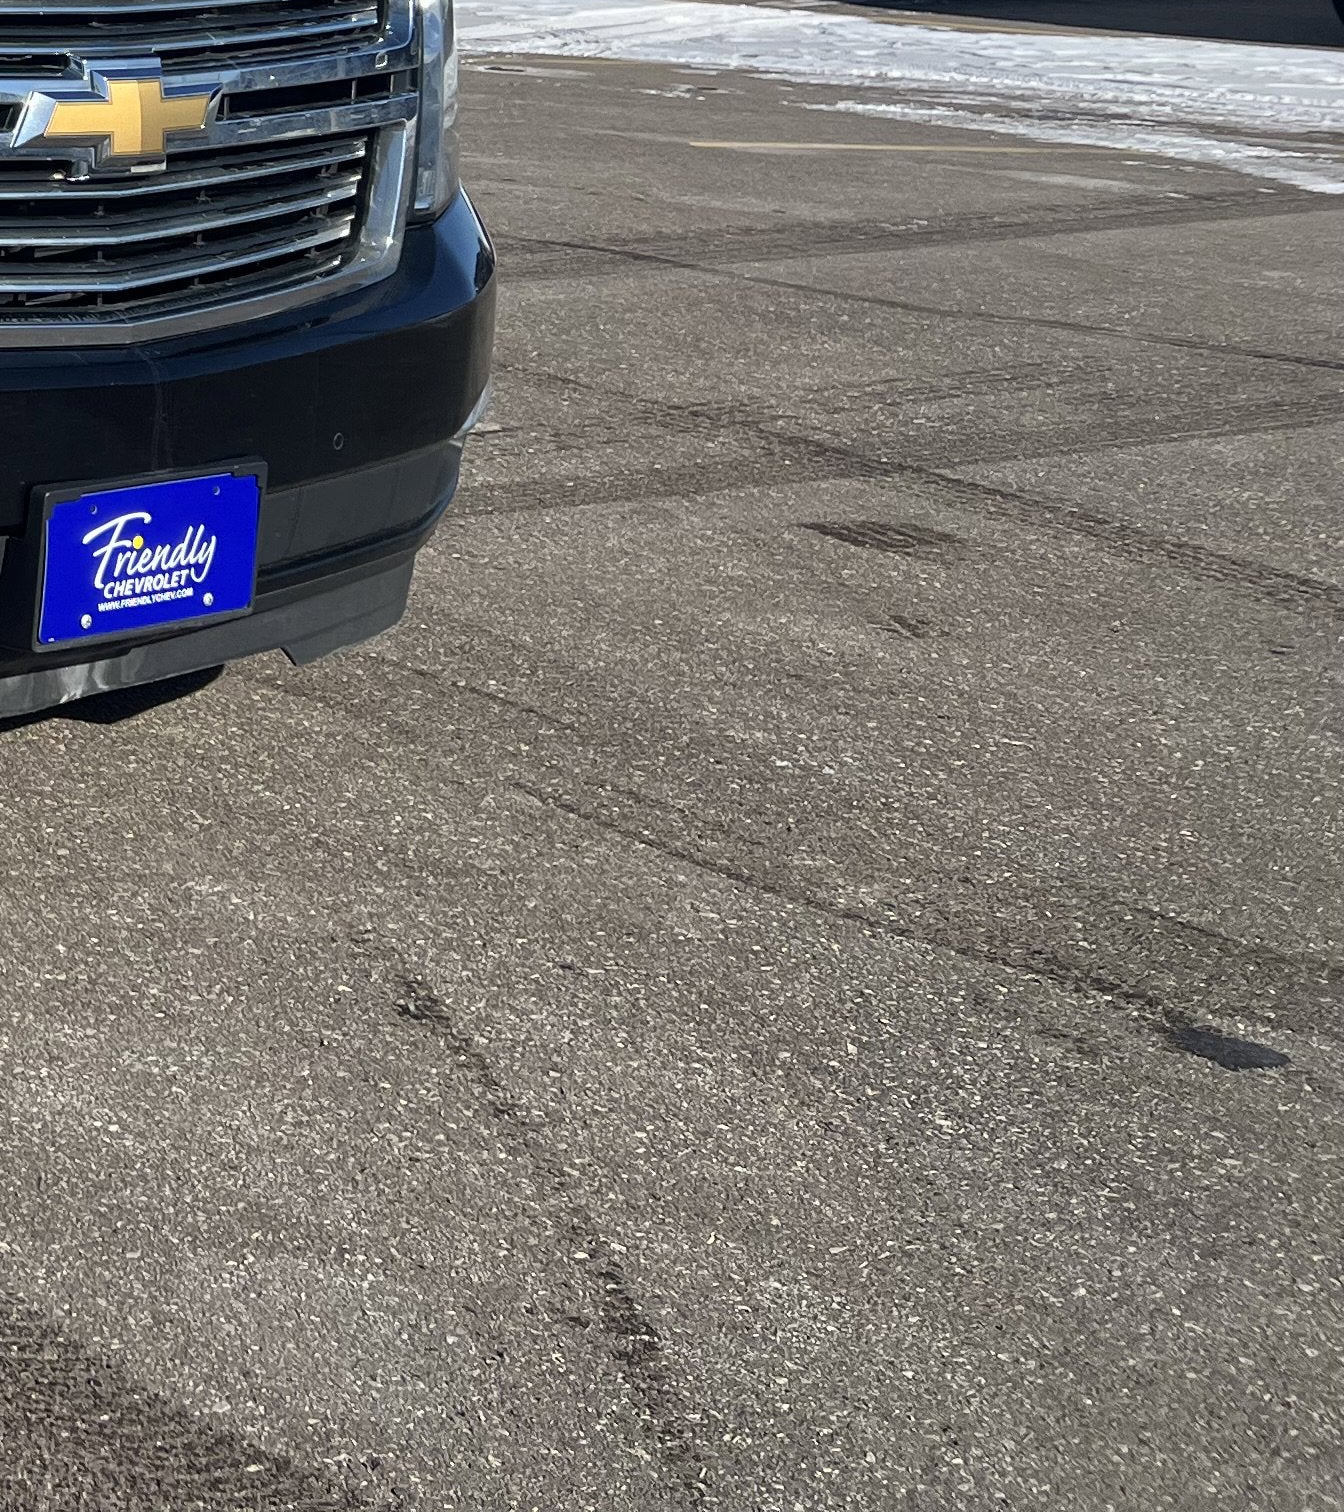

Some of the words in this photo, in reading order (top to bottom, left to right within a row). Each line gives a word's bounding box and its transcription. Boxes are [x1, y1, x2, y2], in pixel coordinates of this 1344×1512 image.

[82, 511, 217, 589] Friendly
[103, 569, 190, 599] CHEVROLET
[98, 587, 194, 612] WWW.FRIENDLYCHEV.COM
